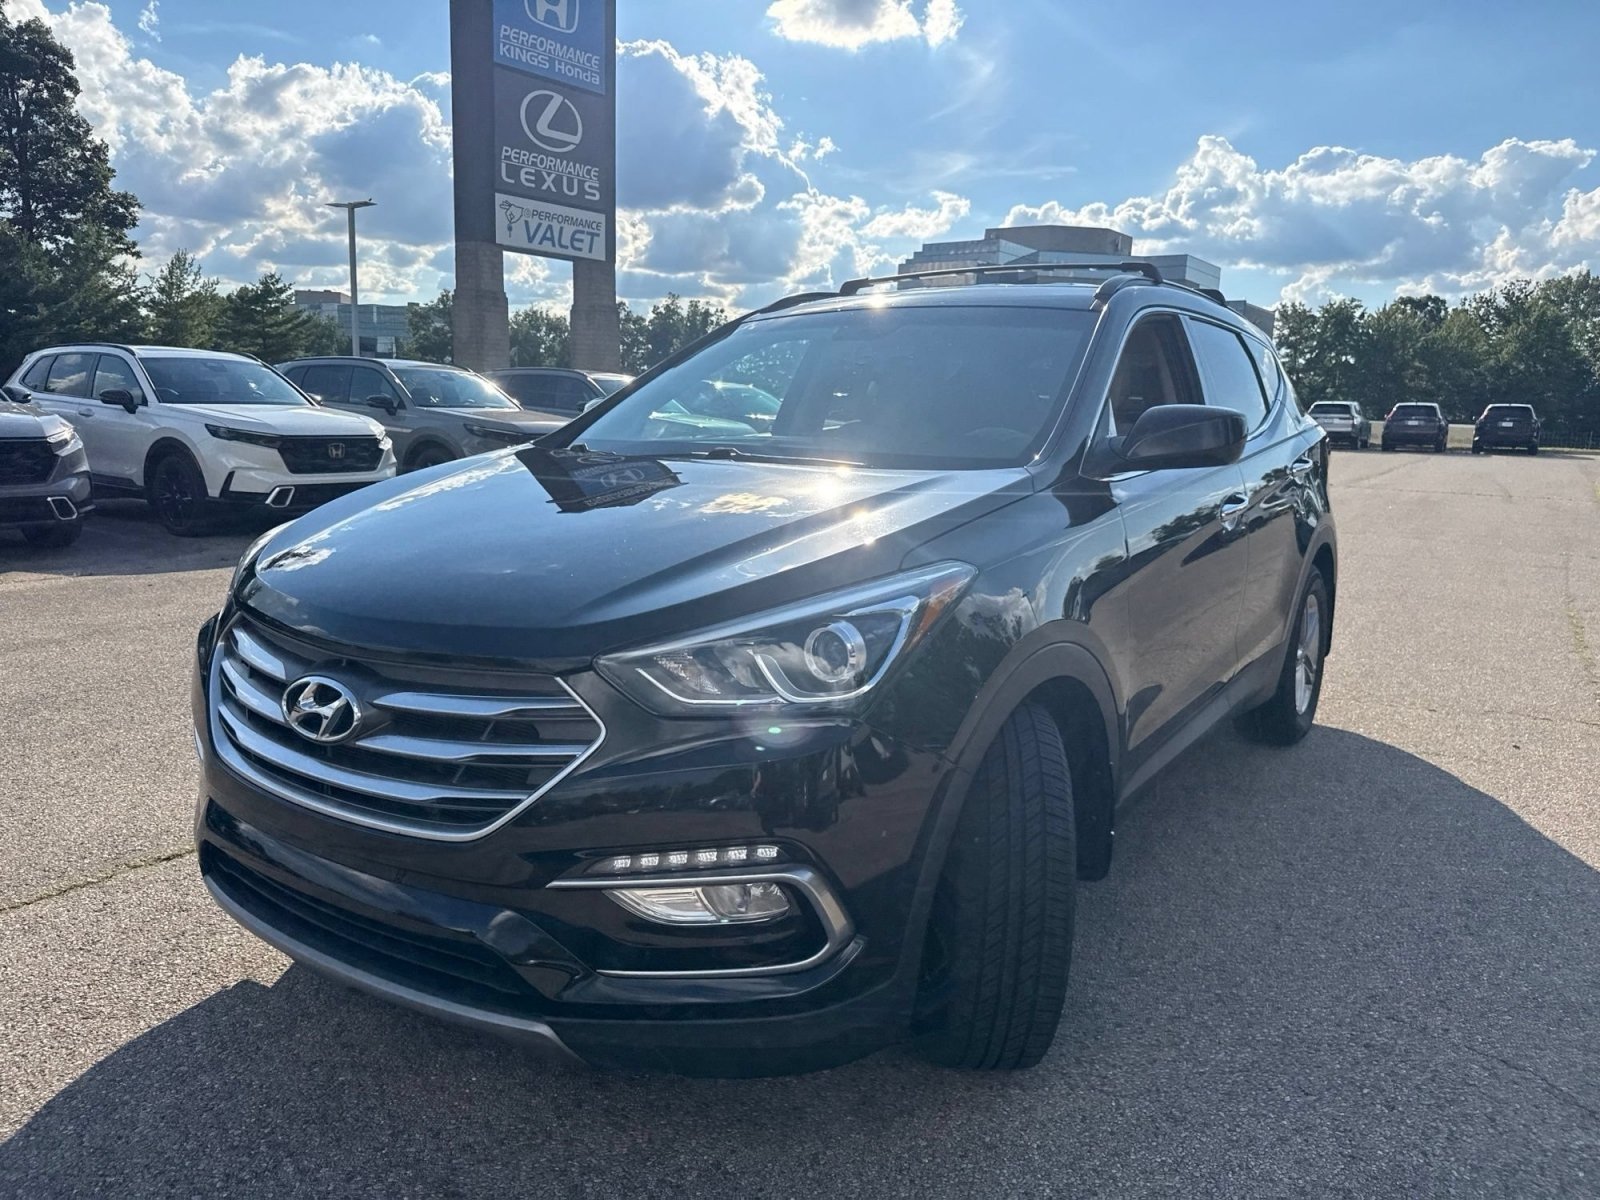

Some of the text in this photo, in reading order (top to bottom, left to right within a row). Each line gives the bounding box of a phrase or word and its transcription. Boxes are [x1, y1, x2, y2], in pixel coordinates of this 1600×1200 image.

[499, 42, 600, 85] KINGS Honda
[500, 25, 600, 68] PERFORMANCE
[501, 146, 600, 180] PERFORMANCE
[501, 162, 600, 201] LEXUS
[524, 219, 600, 253] VALET
[531, 209, 602, 231] PERFORMANCE
